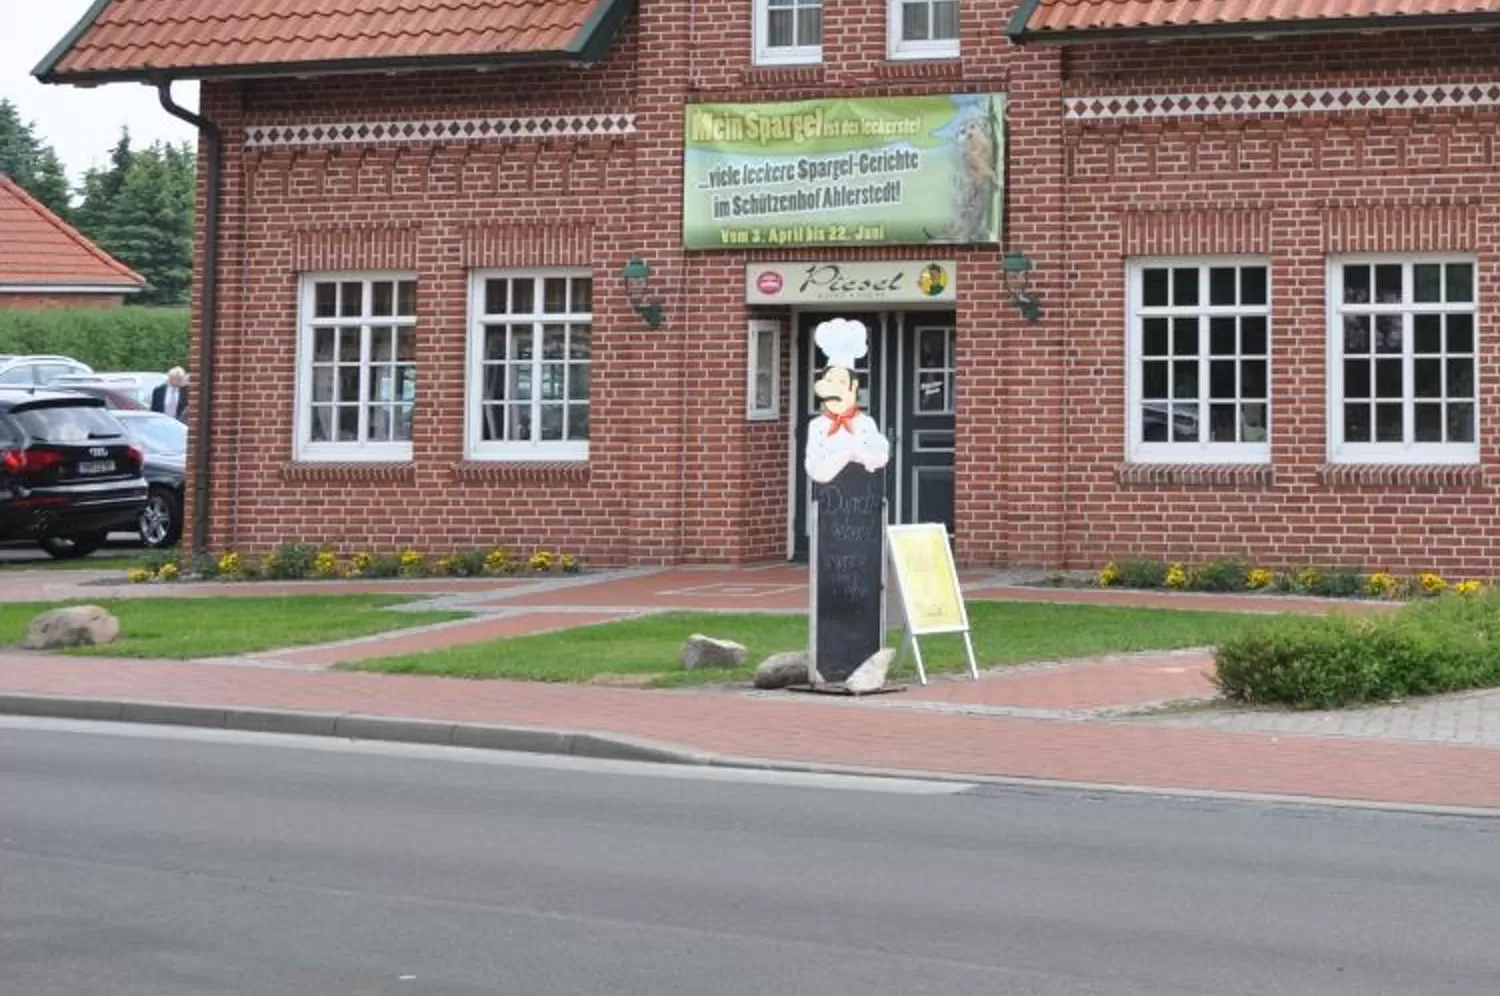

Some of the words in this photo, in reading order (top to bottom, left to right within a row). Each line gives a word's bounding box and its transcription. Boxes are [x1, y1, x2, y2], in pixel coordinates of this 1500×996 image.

[692, 111, 743, 141] Mein
[744, 107, 823, 144] Spargel
[742, 162, 795, 185] leckere
[797, 149, 919, 181] Spargel-Gerichte
[714, 196, 730, 218] im
[732, 187, 822, 216] Schützenhof
[721, 227, 748, 243] Vom
[768, 224, 803, 244] April
[806, 224, 825, 242] bis
[855, 224, 885, 240] Juni
